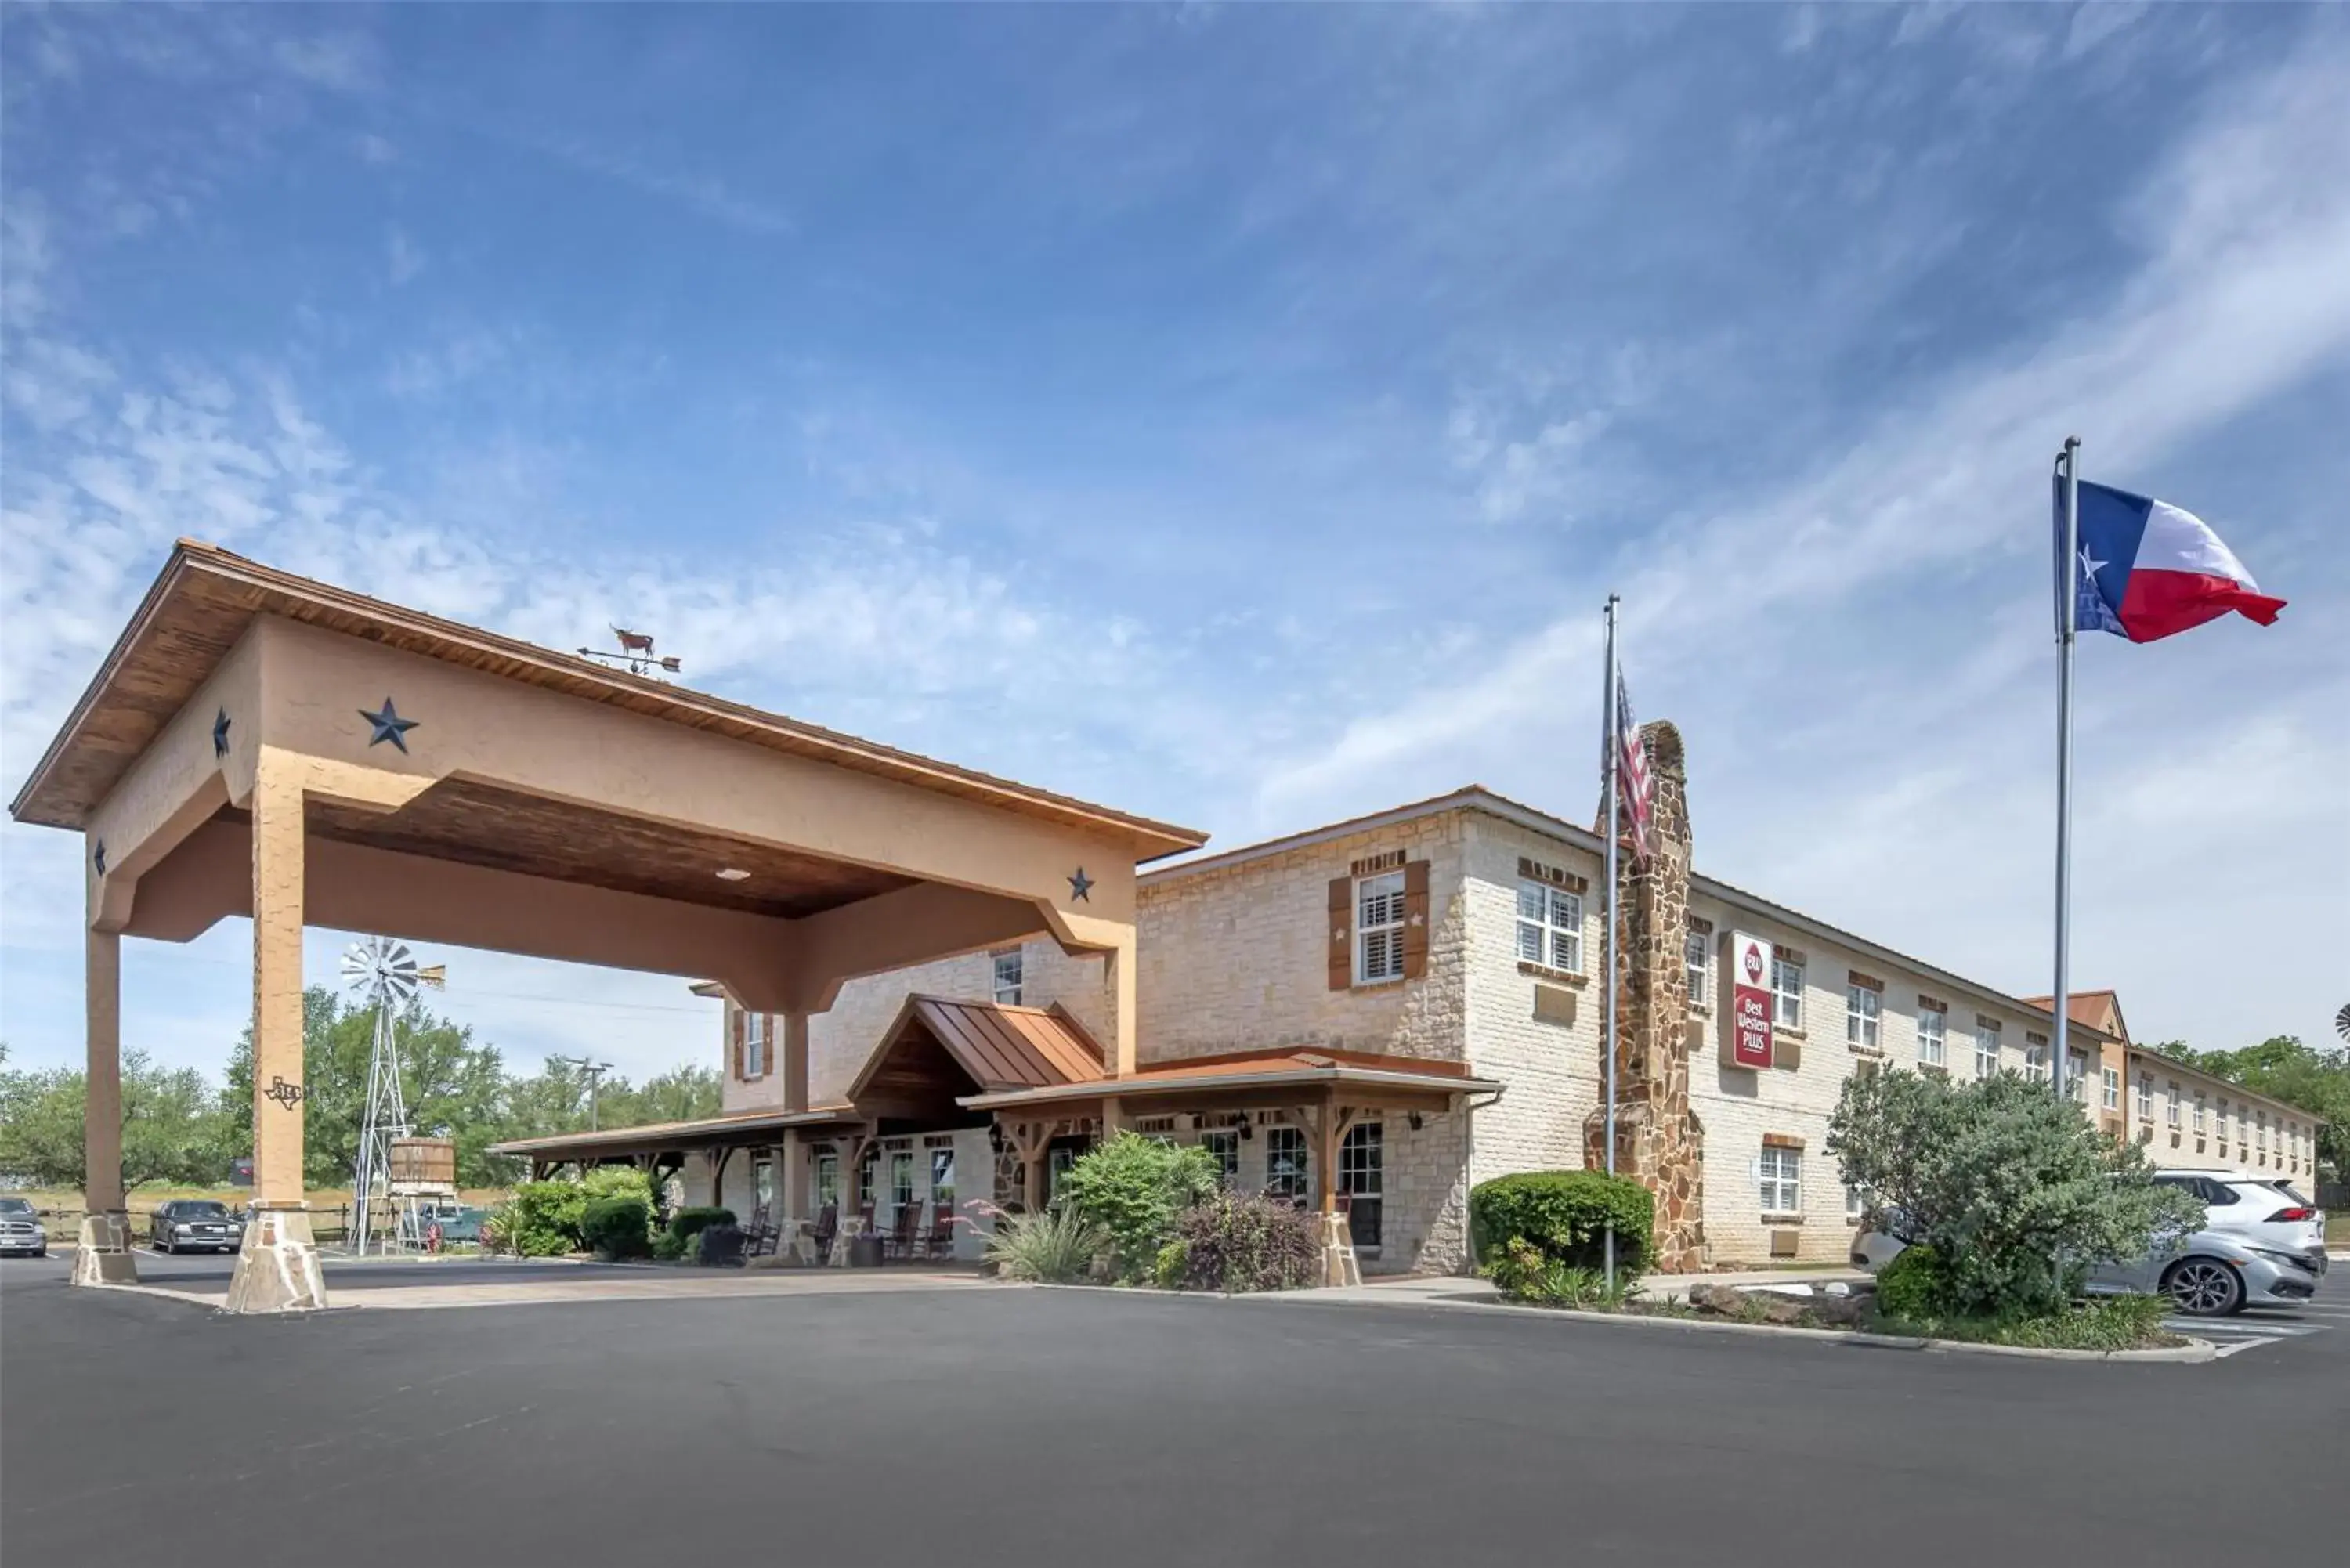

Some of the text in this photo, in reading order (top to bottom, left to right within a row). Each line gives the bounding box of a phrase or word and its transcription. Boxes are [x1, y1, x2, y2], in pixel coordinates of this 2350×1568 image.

[1745, 998, 1762, 1017] Best
[1737, 1012, 1770, 1034] Western
[1743, 1031, 1764, 1050] PLUS
